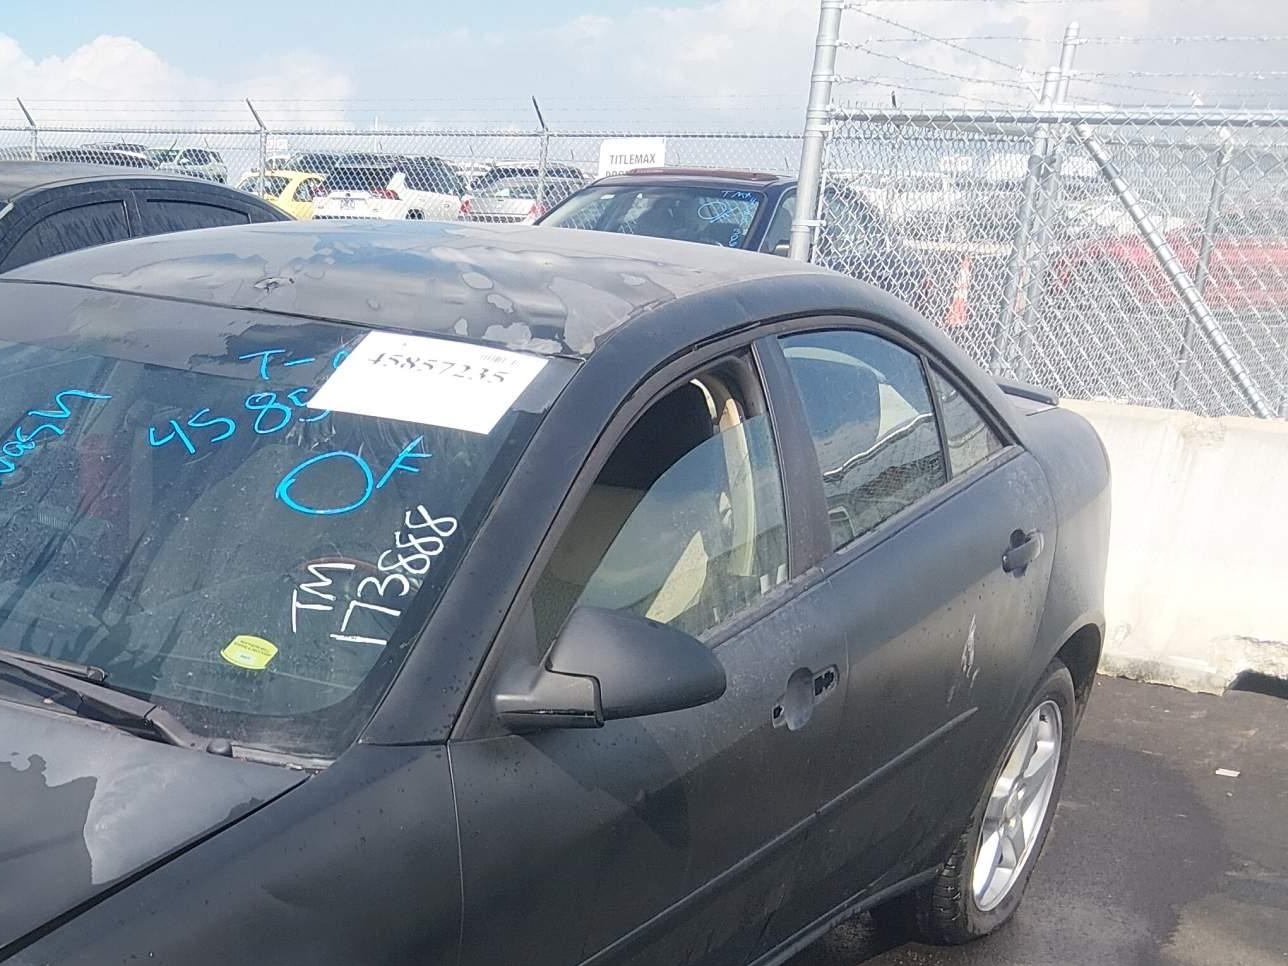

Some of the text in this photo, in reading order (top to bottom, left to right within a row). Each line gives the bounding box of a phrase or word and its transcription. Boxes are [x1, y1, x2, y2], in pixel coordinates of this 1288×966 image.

[608, 152, 656, 165] TITLEMAX
[367, 352, 510, 384] 45857235
[329, 504, 458, 645] 173888
